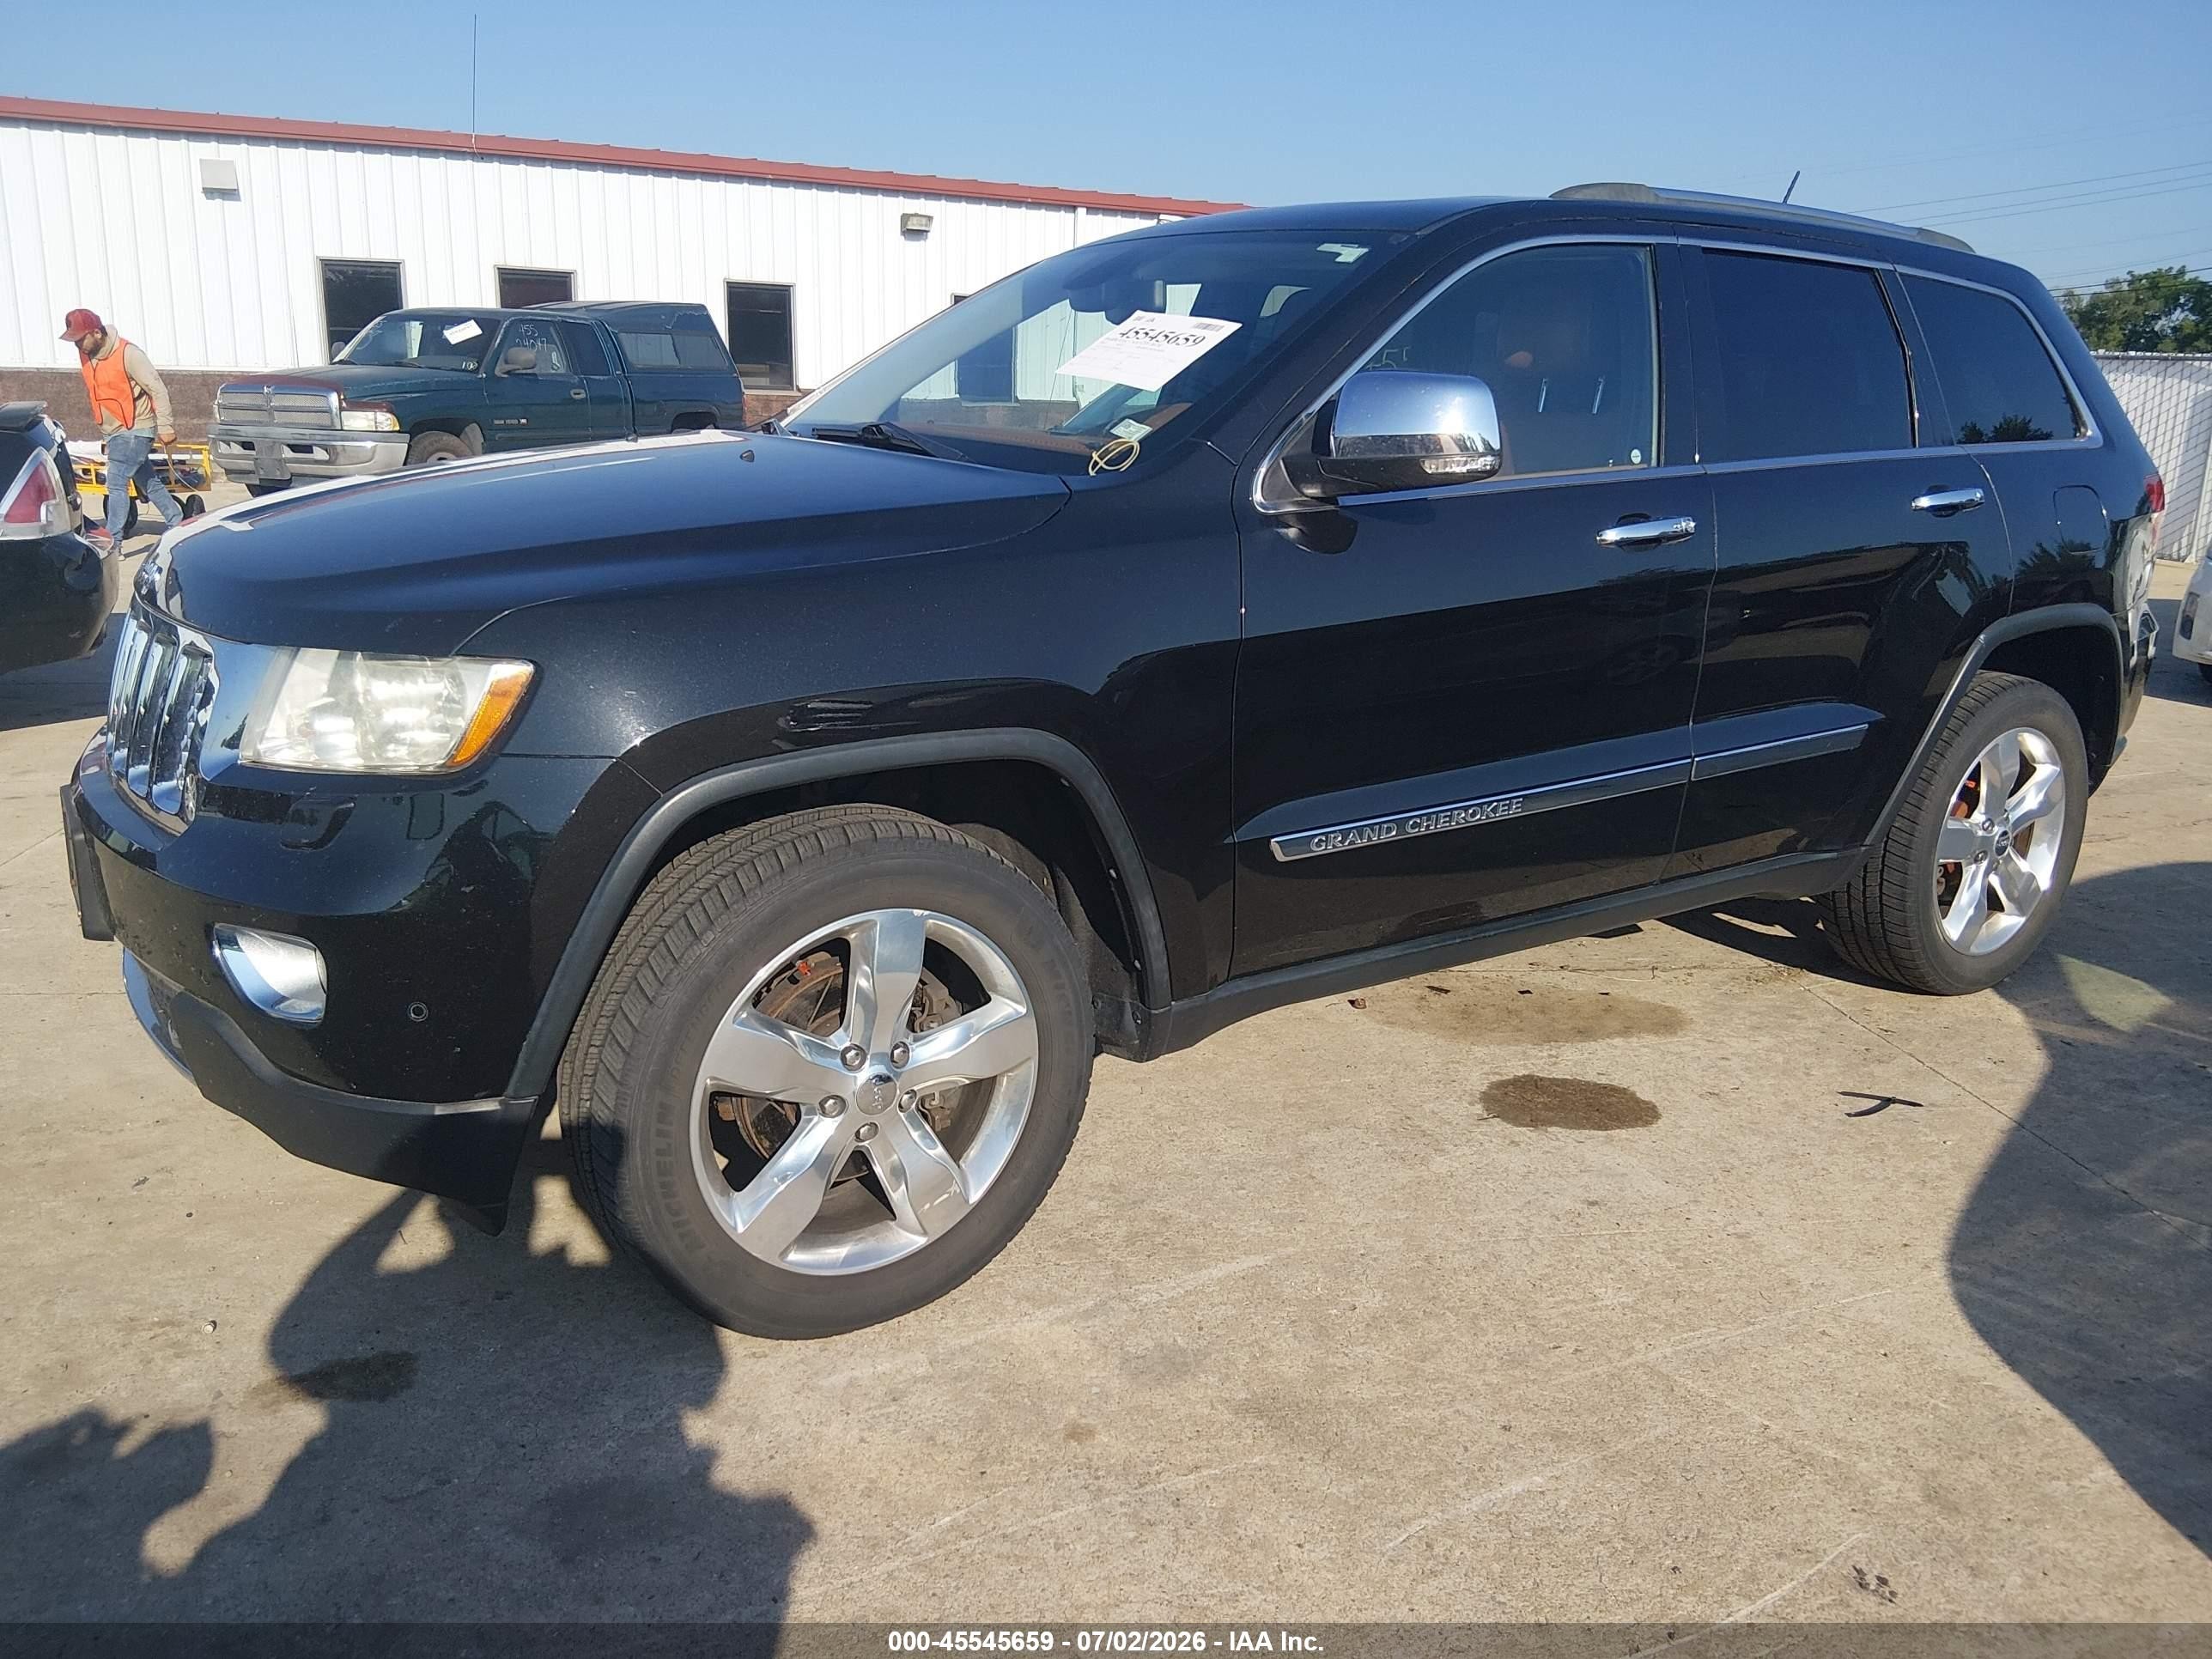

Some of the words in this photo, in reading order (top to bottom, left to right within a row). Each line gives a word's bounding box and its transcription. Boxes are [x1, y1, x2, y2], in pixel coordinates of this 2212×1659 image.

[1119, 327, 1206, 347] 45545659
[1310, 822, 1397, 852] GRAND
[1405, 798, 1523, 834] CHEROKEE
[655, 1100, 703, 1252] MICHELIN
